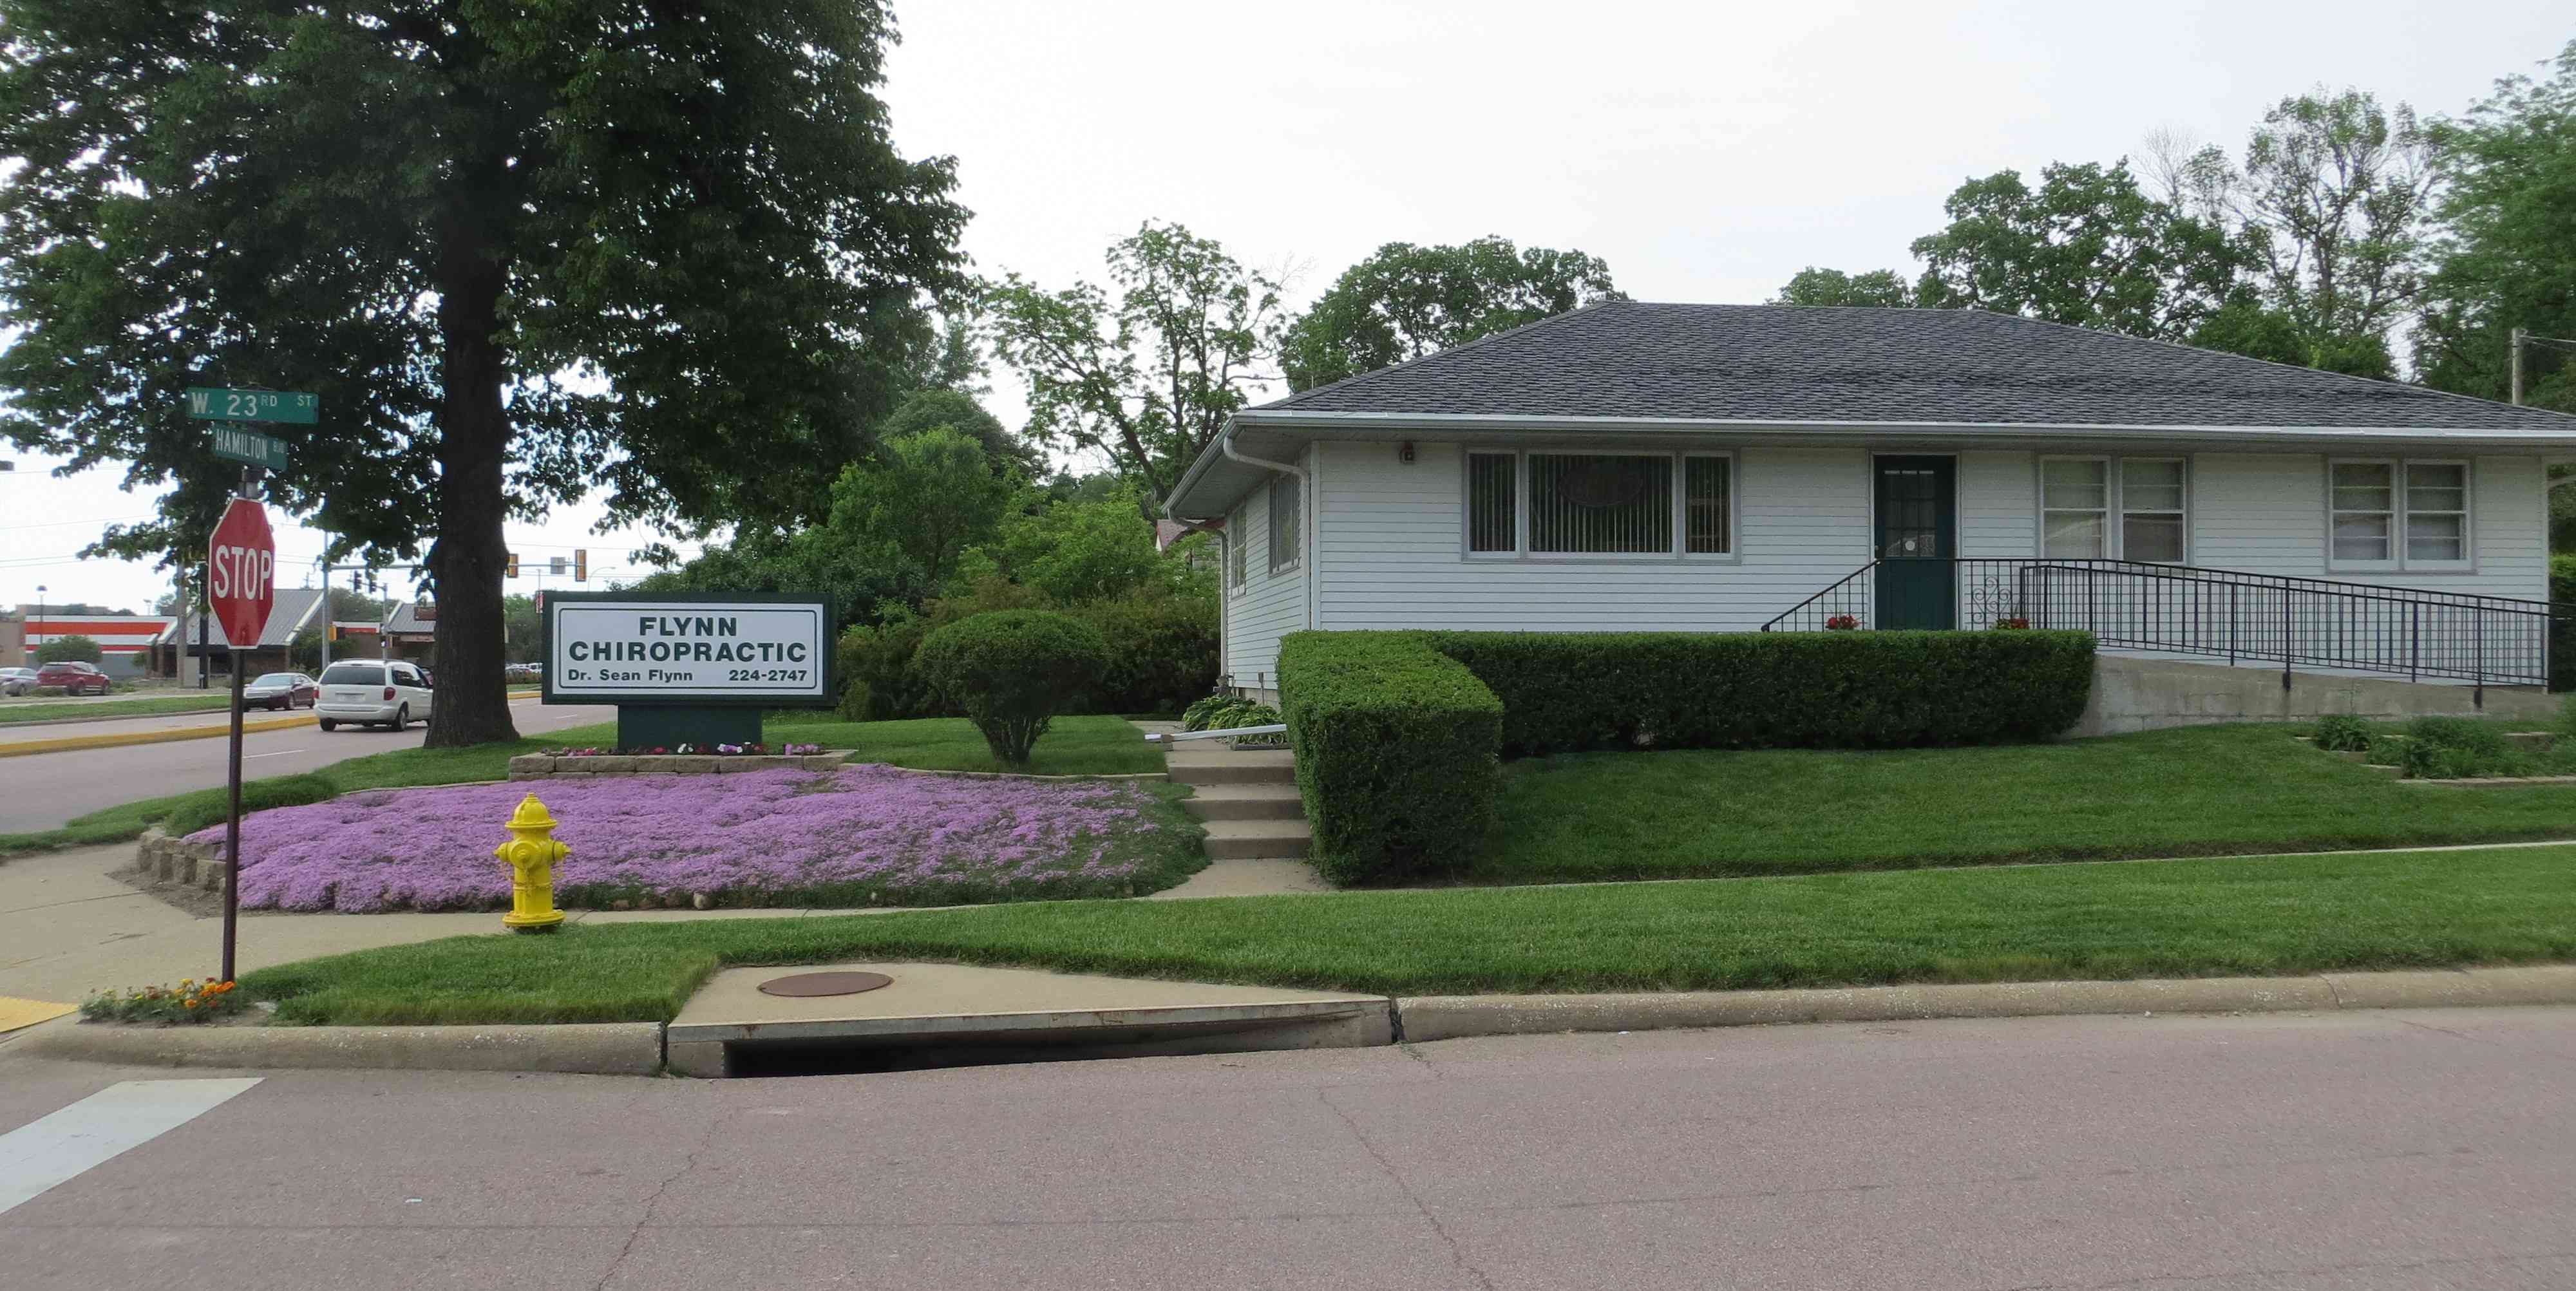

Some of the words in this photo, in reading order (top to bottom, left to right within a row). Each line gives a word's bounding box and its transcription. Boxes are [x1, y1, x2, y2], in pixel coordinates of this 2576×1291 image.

[191, 392, 214, 414] W.
[297, 395, 312, 407] ST
[216, 428, 267, 460] HAMILTON
[214, 545, 272, 600] STOP
[639, 617, 737, 636] FLYNN
[569, 641, 806, 662] CHIROPRACTIC
[568, 669, 591, 681] Dr.
[600, 669, 641, 681] Sean
[649, 669, 693, 683] Flynn
[728, 670, 807, 681] 224-2747
